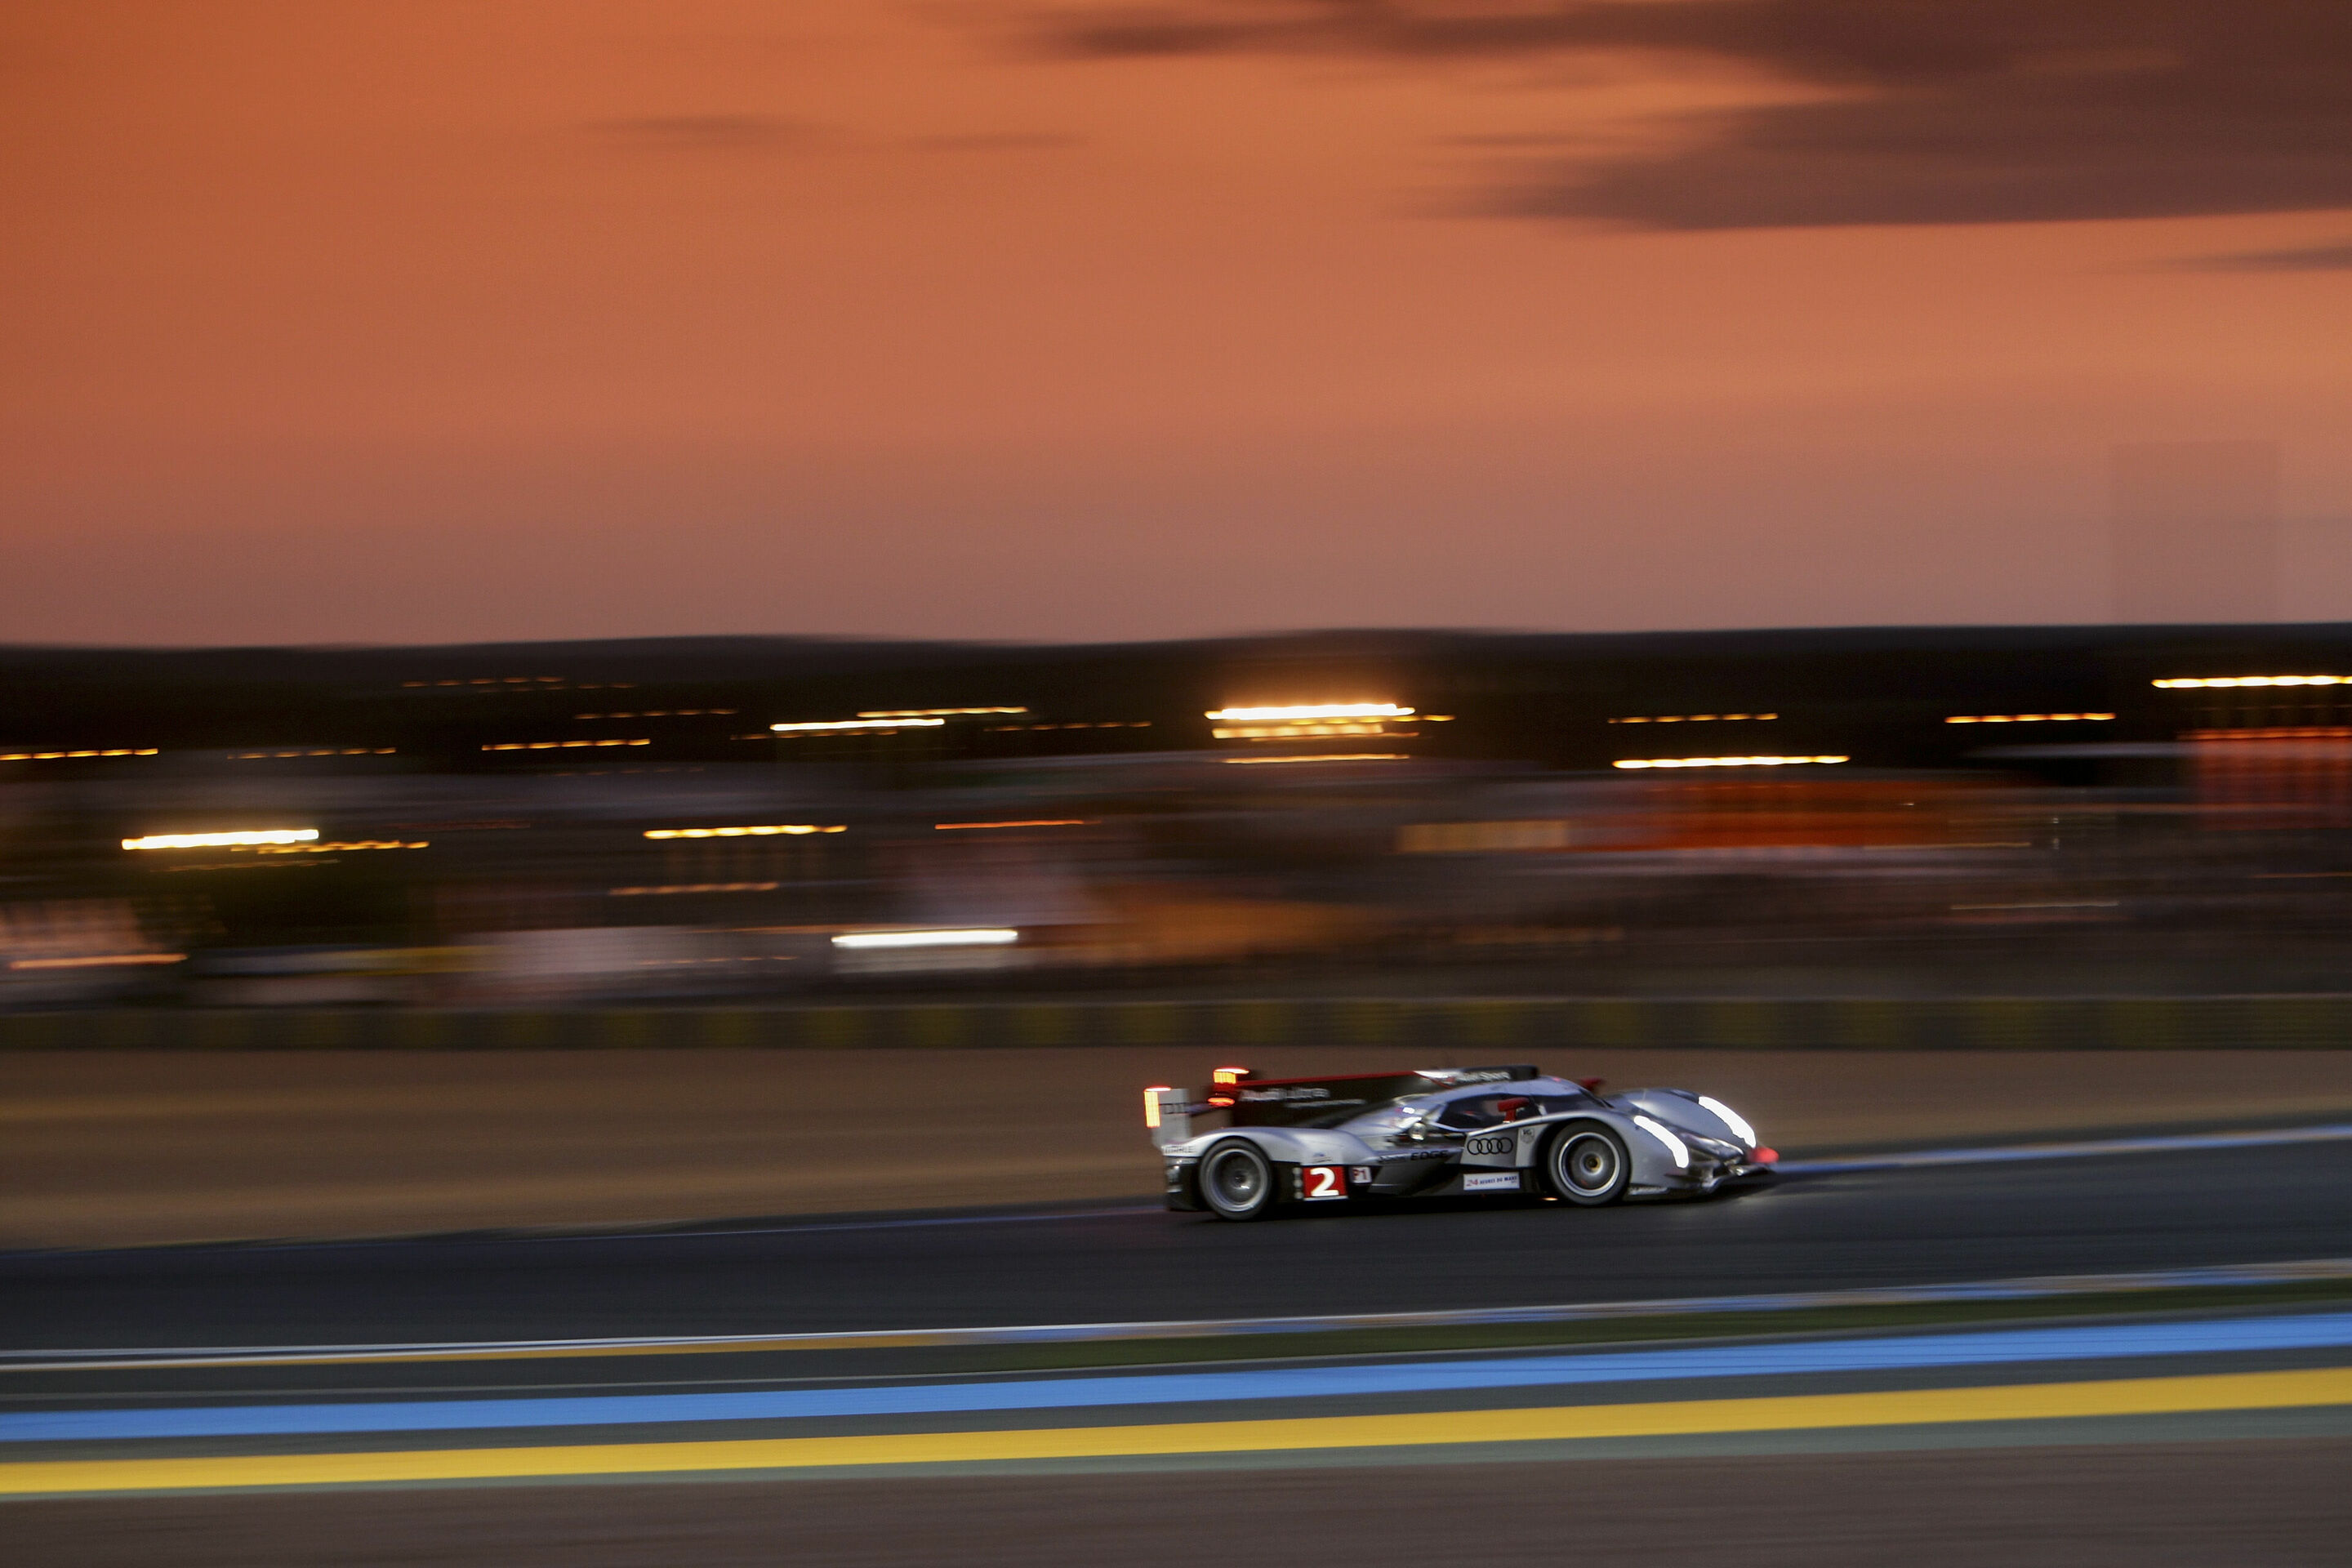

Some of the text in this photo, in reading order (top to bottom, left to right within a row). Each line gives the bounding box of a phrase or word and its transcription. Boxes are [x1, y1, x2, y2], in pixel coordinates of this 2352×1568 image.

[1410, 1150, 1449, 1160] EDGE
[1352, 1169, 1368, 1181] P1
[1310, 1167, 1339, 1197] 2
[1466, 1178, 1478, 1187] 24
